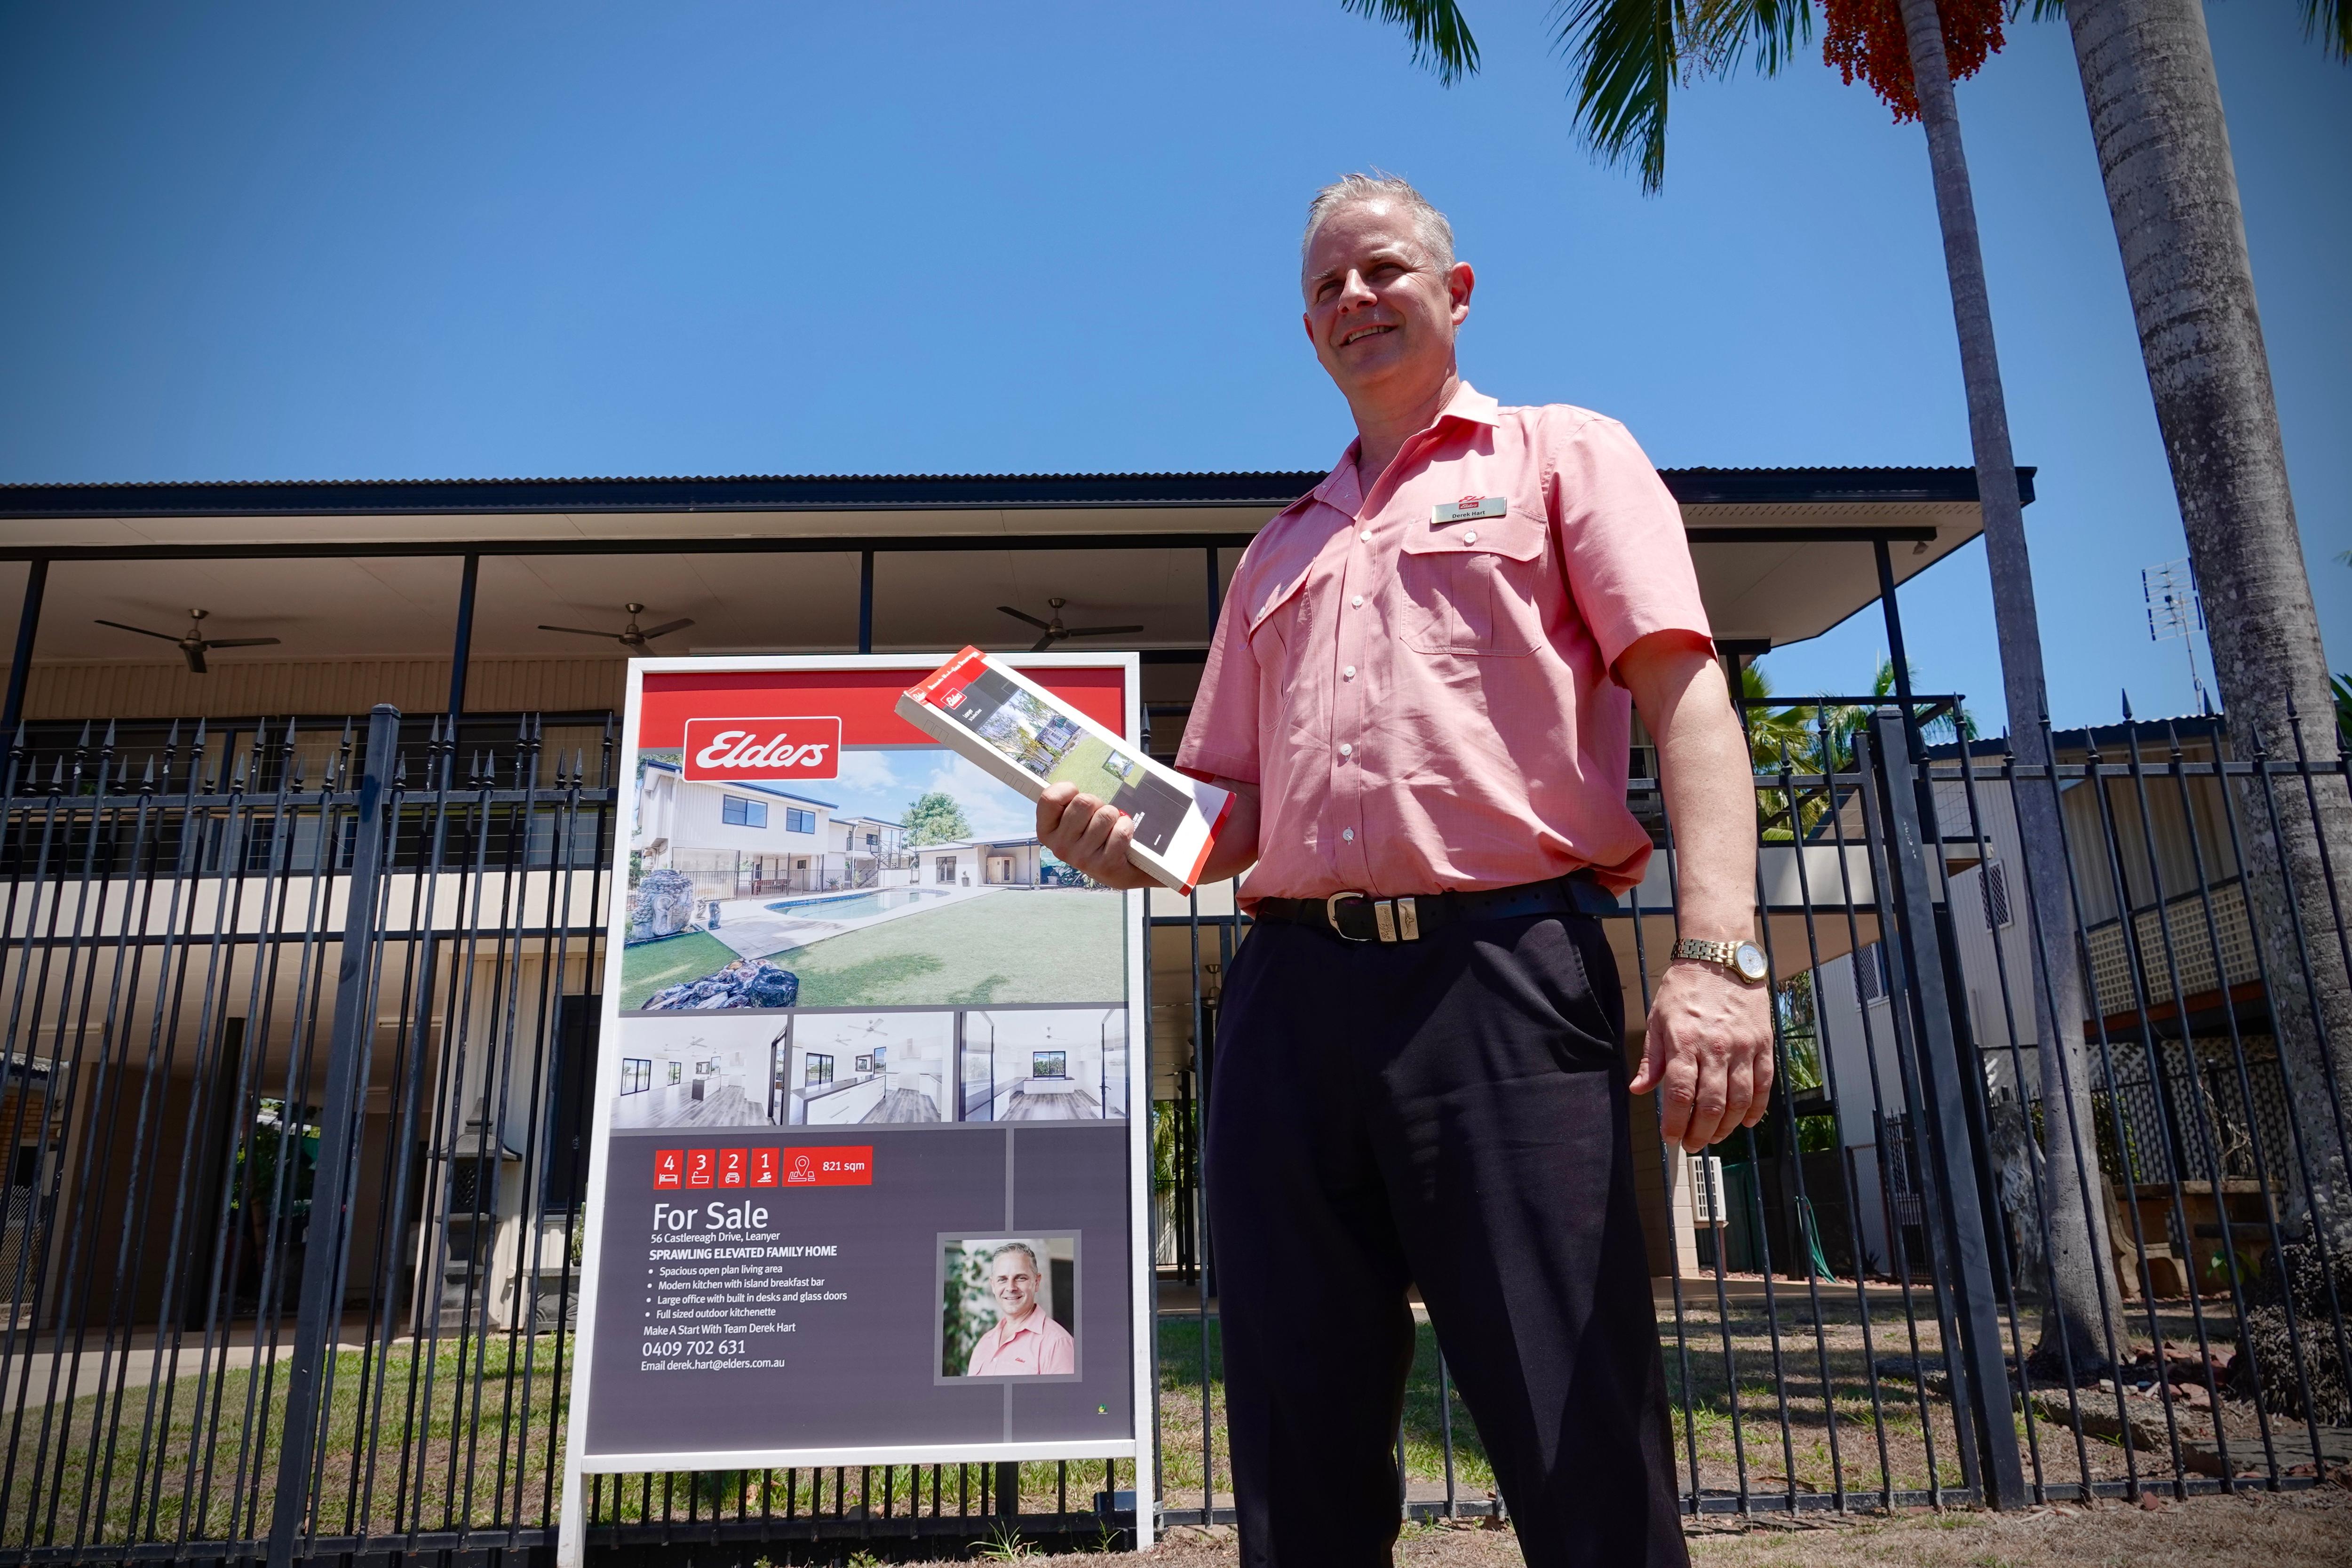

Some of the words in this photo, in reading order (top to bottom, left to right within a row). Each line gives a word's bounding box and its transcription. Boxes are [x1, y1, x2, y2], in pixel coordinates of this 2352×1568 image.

[946, 692, 963, 707] Elders
[696, 730, 829, 768] Elders
[664, 1155, 675, 1170] 4
[696, 1154, 706, 1170] 3
[729, 1154, 739, 1169] 2
[761, 1154, 769, 1168] 1
[823, 1161, 841, 1171] 821
[844, 1162, 865, 1173] sqm
[653, 1203, 699, 1231] For
[706, 1200, 768, 1230] Sale
[651, 1234, 663, 1243] 56
[664, 1233, 716, 1244] Castlereagh
[718, 1232, 743, 1242] Drive,
[746, 1232, 780, 1242] Leanyer
[649, 1248, 712, 1261] SPRAWLING
[714, 1248, 764, 1259] ELEVATED
[766, 1246, 804, 1258] FAMILY
[805, 1245, 837, 1257] HOME
[659, 1266, 697, 1278] Spacious
[699, 1267, 719, 1277] open
[721, 1265, 739, 1276] plan
[741, 1265, 763, 1275] living
[658, 1280, 691, 1290] Modern
[692, 1280, 723, 1289] kitchen
[724, 1278, 742, 1288] with
[744, 1278, 769, 1288] island
[771, 1277, 809, 1287] breakfast
[811, 1277, 825, 1286] bar
[658, 1296, 681, 1306] Large
[682, 1294, 706, 1304] office
[707, 1293, 724, 1303] with
[726, 1293, 745, 1303] built
[747, 1293, 754, 1302] in
[756, 1293, 781, 1302] desks
[782, 1292, 798, 1301] and
[800, 1292, 822, 1303] glass
[823, 1291, 847, 1300] doors
[656, 1310, 670, 1319] Full
[672, 1309, 694, 1319] sized
[695, 1308, 728, 1318] outdoor
[730, 1307, 776, 1317] kitchenette
[644, 1326, 668, 1336] Make
[669, 1325, 676, 1335] A
[678, 1325, 700, 1335] Start
[701, 1324, 722, 1334] With
[723, 1324, 747, 1333] Team
[749, 1322, 775, 1333] Derek
[777, 1322, 796, 1332] Hart
[642, 1341, 682, 1357] 0409
[686, 1340, 714, 1355] 702
[718, 1340, 745, 1354] 631
[641, 1361, 665, 1371] Email
[667, 1359, 785, 1370] derek.hart@elders.com.au
